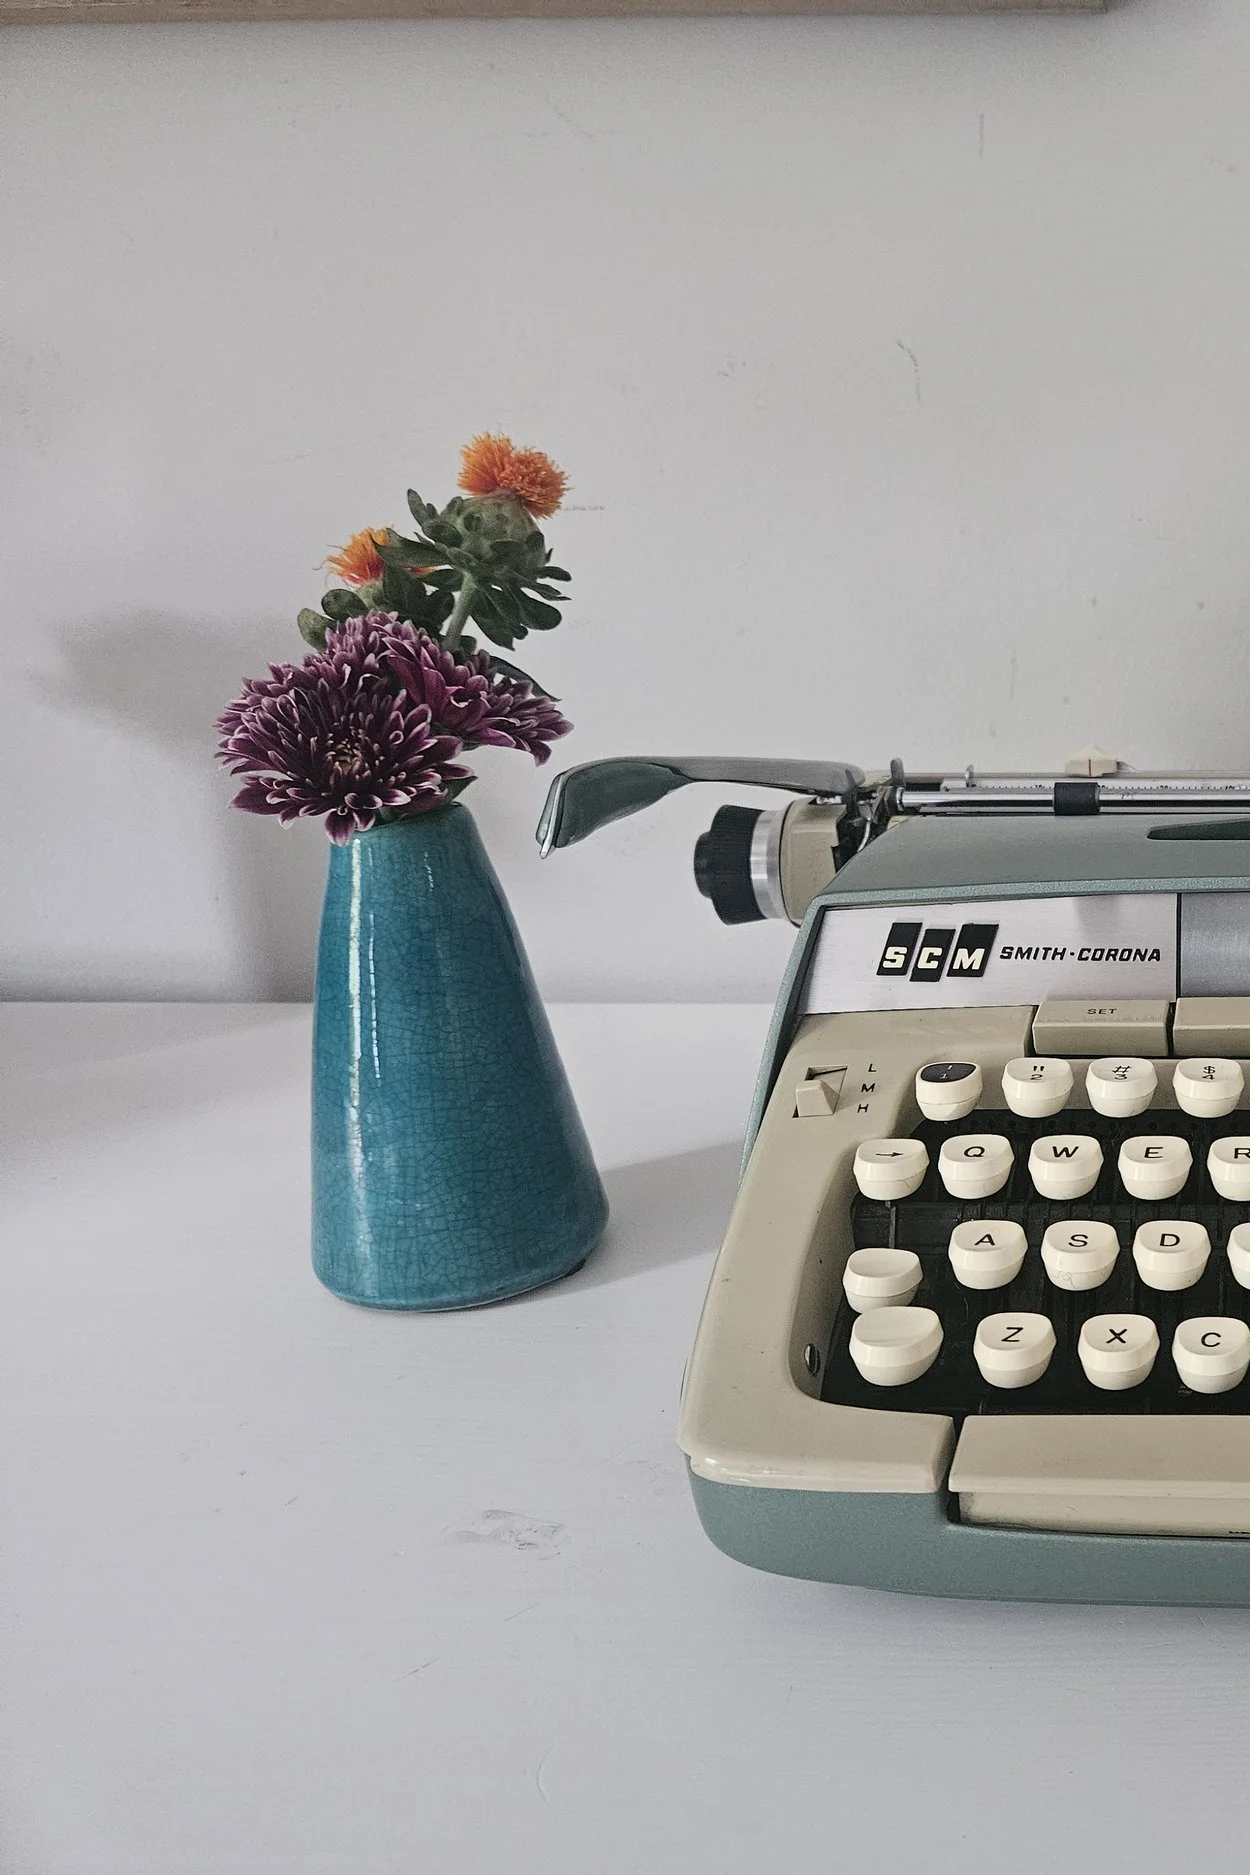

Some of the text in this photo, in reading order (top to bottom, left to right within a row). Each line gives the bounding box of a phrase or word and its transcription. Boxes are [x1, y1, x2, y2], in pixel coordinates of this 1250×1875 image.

[882, 945, 986, 971] SCM
[868, 1064, 876, 1072] L
[1203, 1066, 1215, 1074] $
[861, 1083, 875, 1092] M
[857, 1104, 868, 1113] H
[964, 1146, 985, 1157] Q
[1053, 1146, 1079, 1158] W
[1144, 1147, 1163, 1158] E
[975, 1234, 995, 1245] A
[1069, 1234, 1088, 1247] S
[1160, 1234, 1180, 1246] D
[1002, 1327, 1023, 1342] Z
[1106, 1329, 1127, 1343] X
[1201, 1332, 1221, 1347] C
